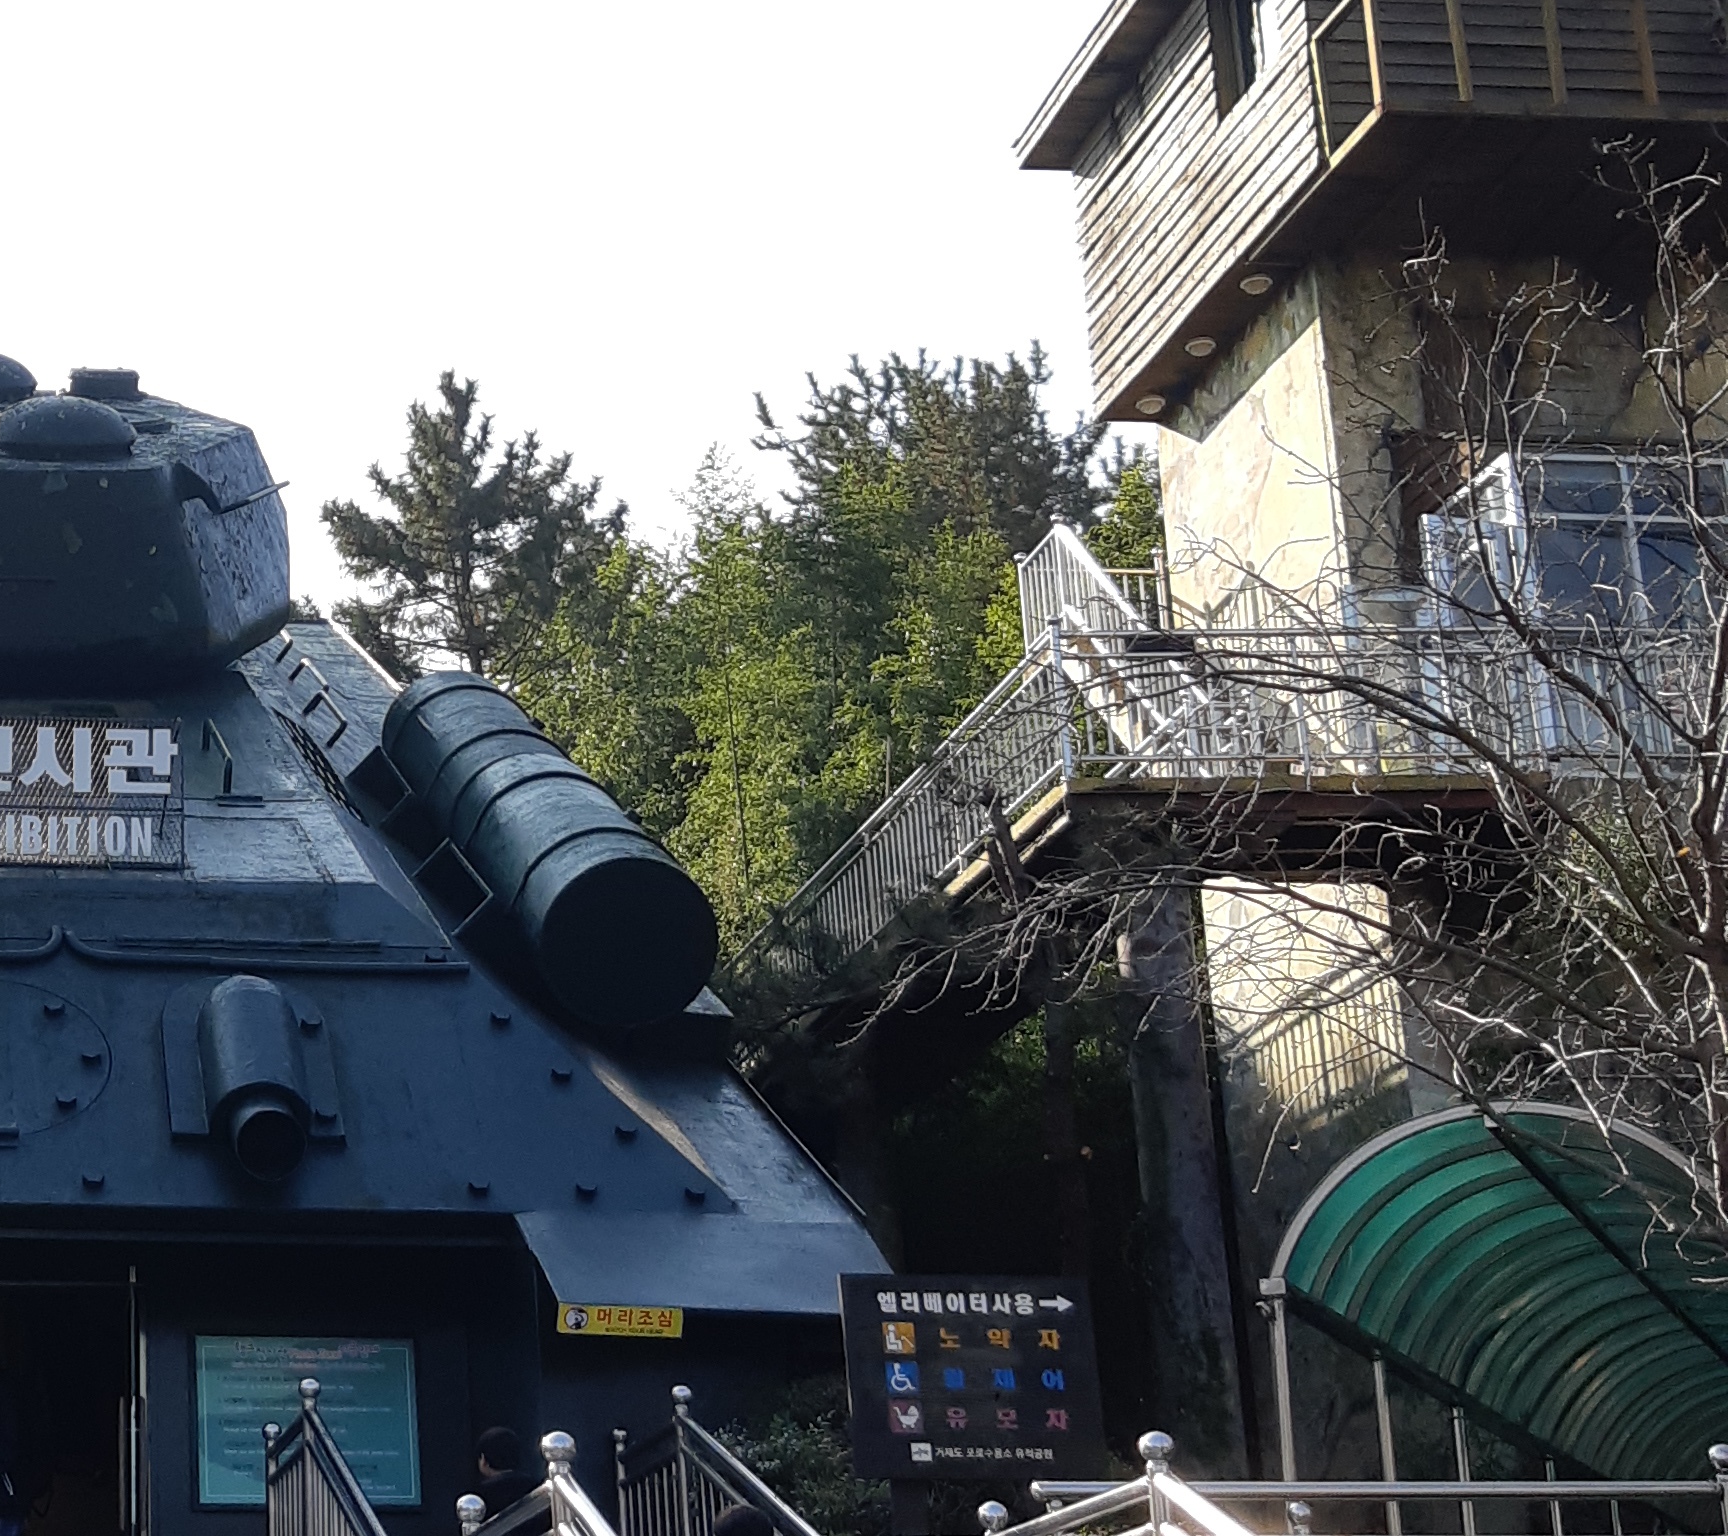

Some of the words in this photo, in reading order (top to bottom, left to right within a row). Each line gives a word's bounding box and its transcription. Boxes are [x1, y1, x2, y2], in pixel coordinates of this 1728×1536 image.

[877, 1291, 1035, 1315] 엘리베이터사용
[596, 1308, 673, 1327] 머리조심
[939, 1327, 1061, 1350] 노약자
[943, 1368, 1065, 1391] 체어
